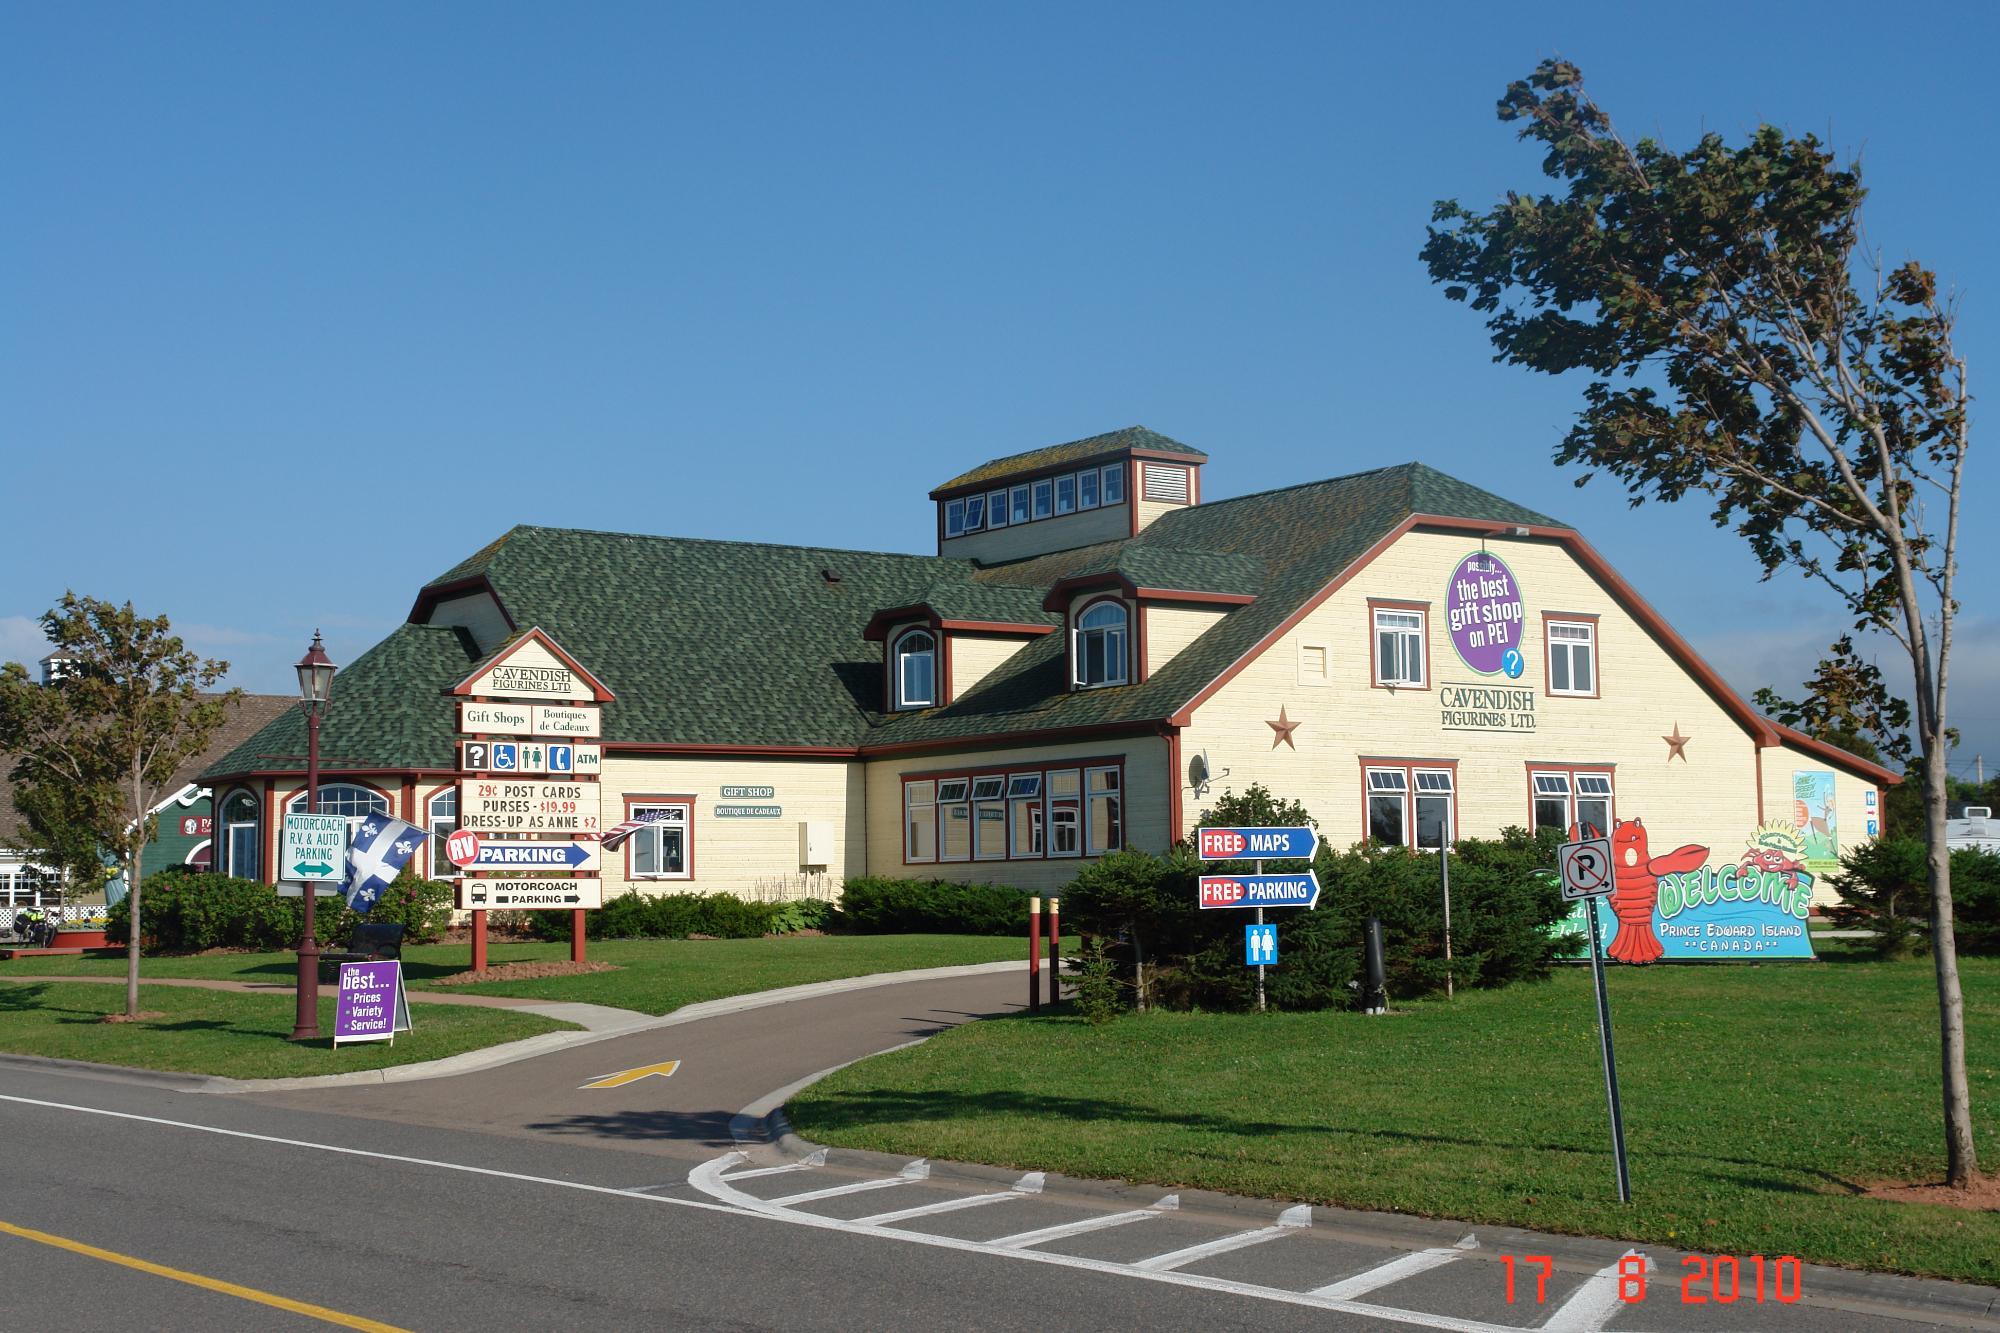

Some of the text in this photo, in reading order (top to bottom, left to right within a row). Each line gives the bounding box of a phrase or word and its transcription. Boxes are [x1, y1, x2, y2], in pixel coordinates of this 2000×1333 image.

[1457, 574, 1509, 601] the best
[1450, 598, 1522, 631] gift shop
[1469, 621, 1509, 648] on PEI
[492, 667, 571, 683] CAVENDISH
[493, 679, 571, 692] FIGURINES LTD.
[1440, 687, 1535, 711] CAVENDISH
[467, 710, 525, 726] Gift Shops
[543, 709, 587, 721] Boutiques
[1441, 711, 1536, 728] FIGURINES LTD.
[540, 721, 590, 732] de Cadeaux
[576, 754, 598, 764] ATM
[478, 785, 581, 799] 29¢ POST CARDS
[723, 787, 773, 797] GIFT SHOP
[483, 800, 530, 813] PURSES
[540, 801, 576, 813] $19.99
[716, 807, 746, 816] BOUTIQUE
[754, 807, 781, 815] CADEAUX
[287, 816, 343, 831] MOTORCOACH
[463, 815, 597, 829] DRESS-UP AS ANNE $2
[290, 832, 339, 846] R.V. & AUTO
[1204, 834, 1290, 852] FREE MAPS
[295, 847, 333, 861] PARKING
[450, 835, 475, 861] RV
[479, 848, 566, 863] PARKING
[495, 882, 578, 891] MOTORCOACH
[1203, 881, 1307, 901] FREE PARKING
[1658, 864, 1813, 920] WELCOME
[511, 895, 562, 904] PARKING
[1659, 922, 1802, 937] PRINCE EDWARD ISLAND
[347, 967, 360, 977] the
[342, 972, 390, 990] best...
[353, 992, 381, 1004] Prices
[352, 1005, 383, 1017] Variety
[350, 1018, 387, 1031] Service!
